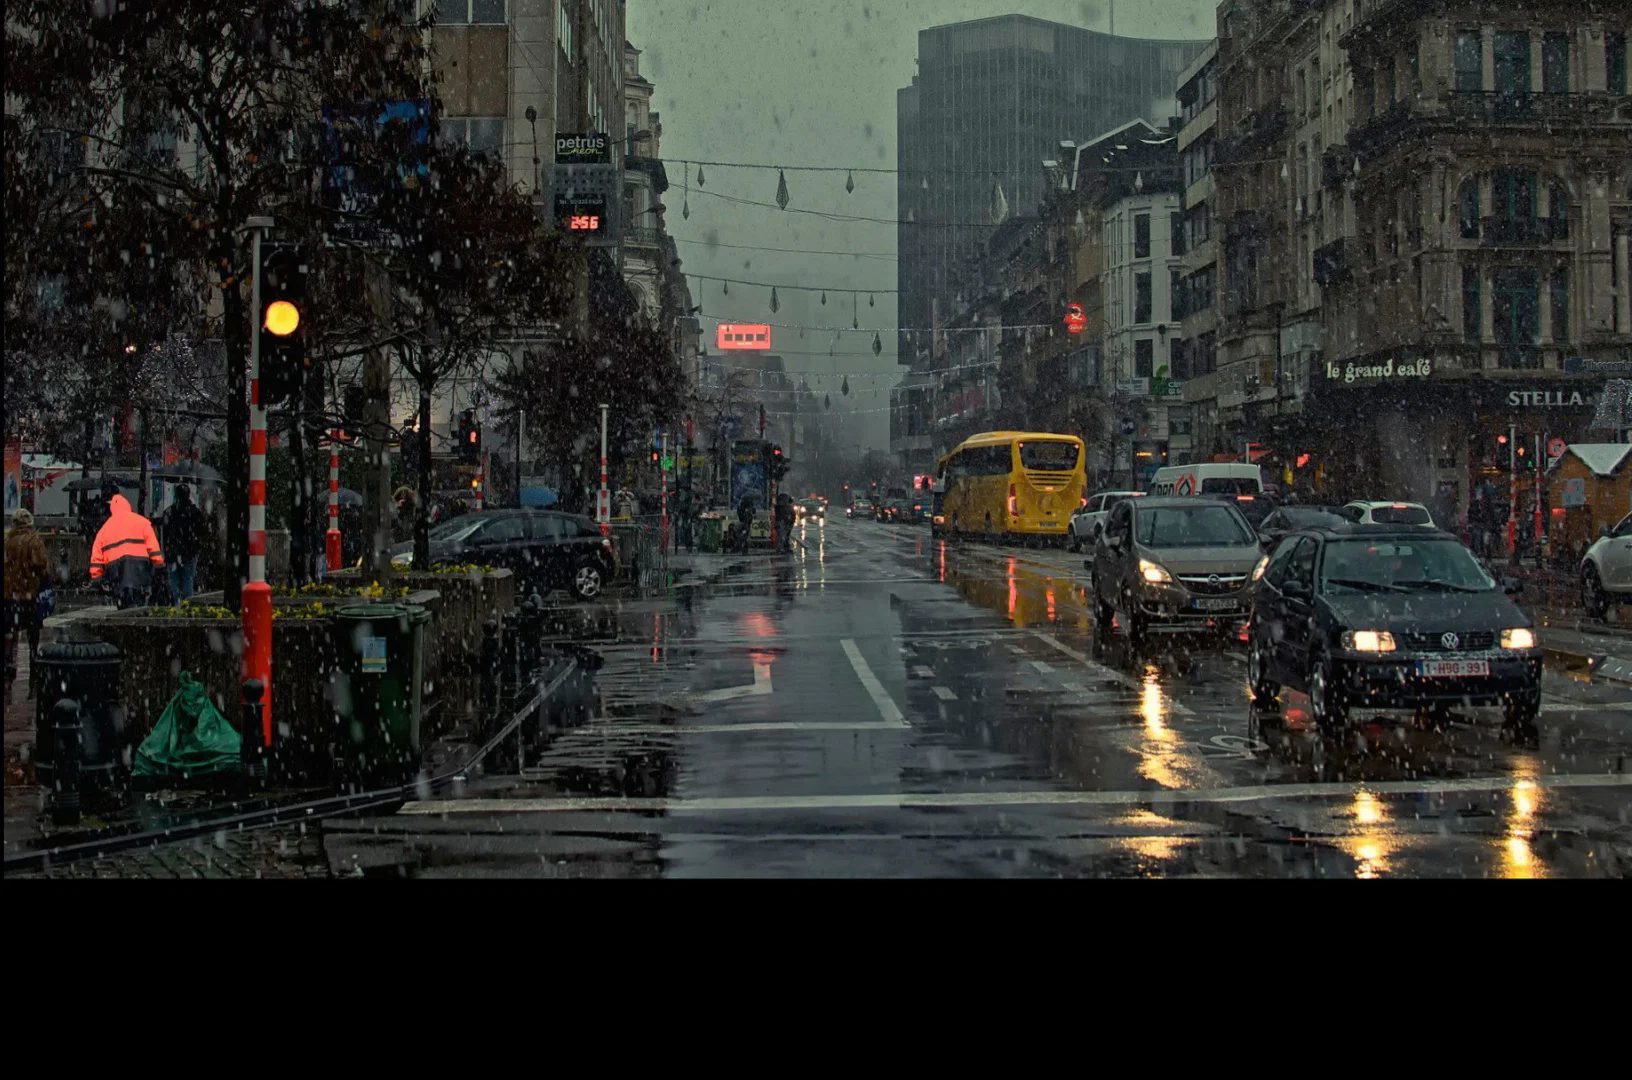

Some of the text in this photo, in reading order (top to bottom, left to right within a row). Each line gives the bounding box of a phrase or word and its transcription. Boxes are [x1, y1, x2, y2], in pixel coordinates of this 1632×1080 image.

[556, 135, 605, 153] petrus
[1326, 358, 1431, 384] le grand café
[1508, 390, 1584, 407] STELLA
[1425, 662, 1487, 674] 1-HBG-991
